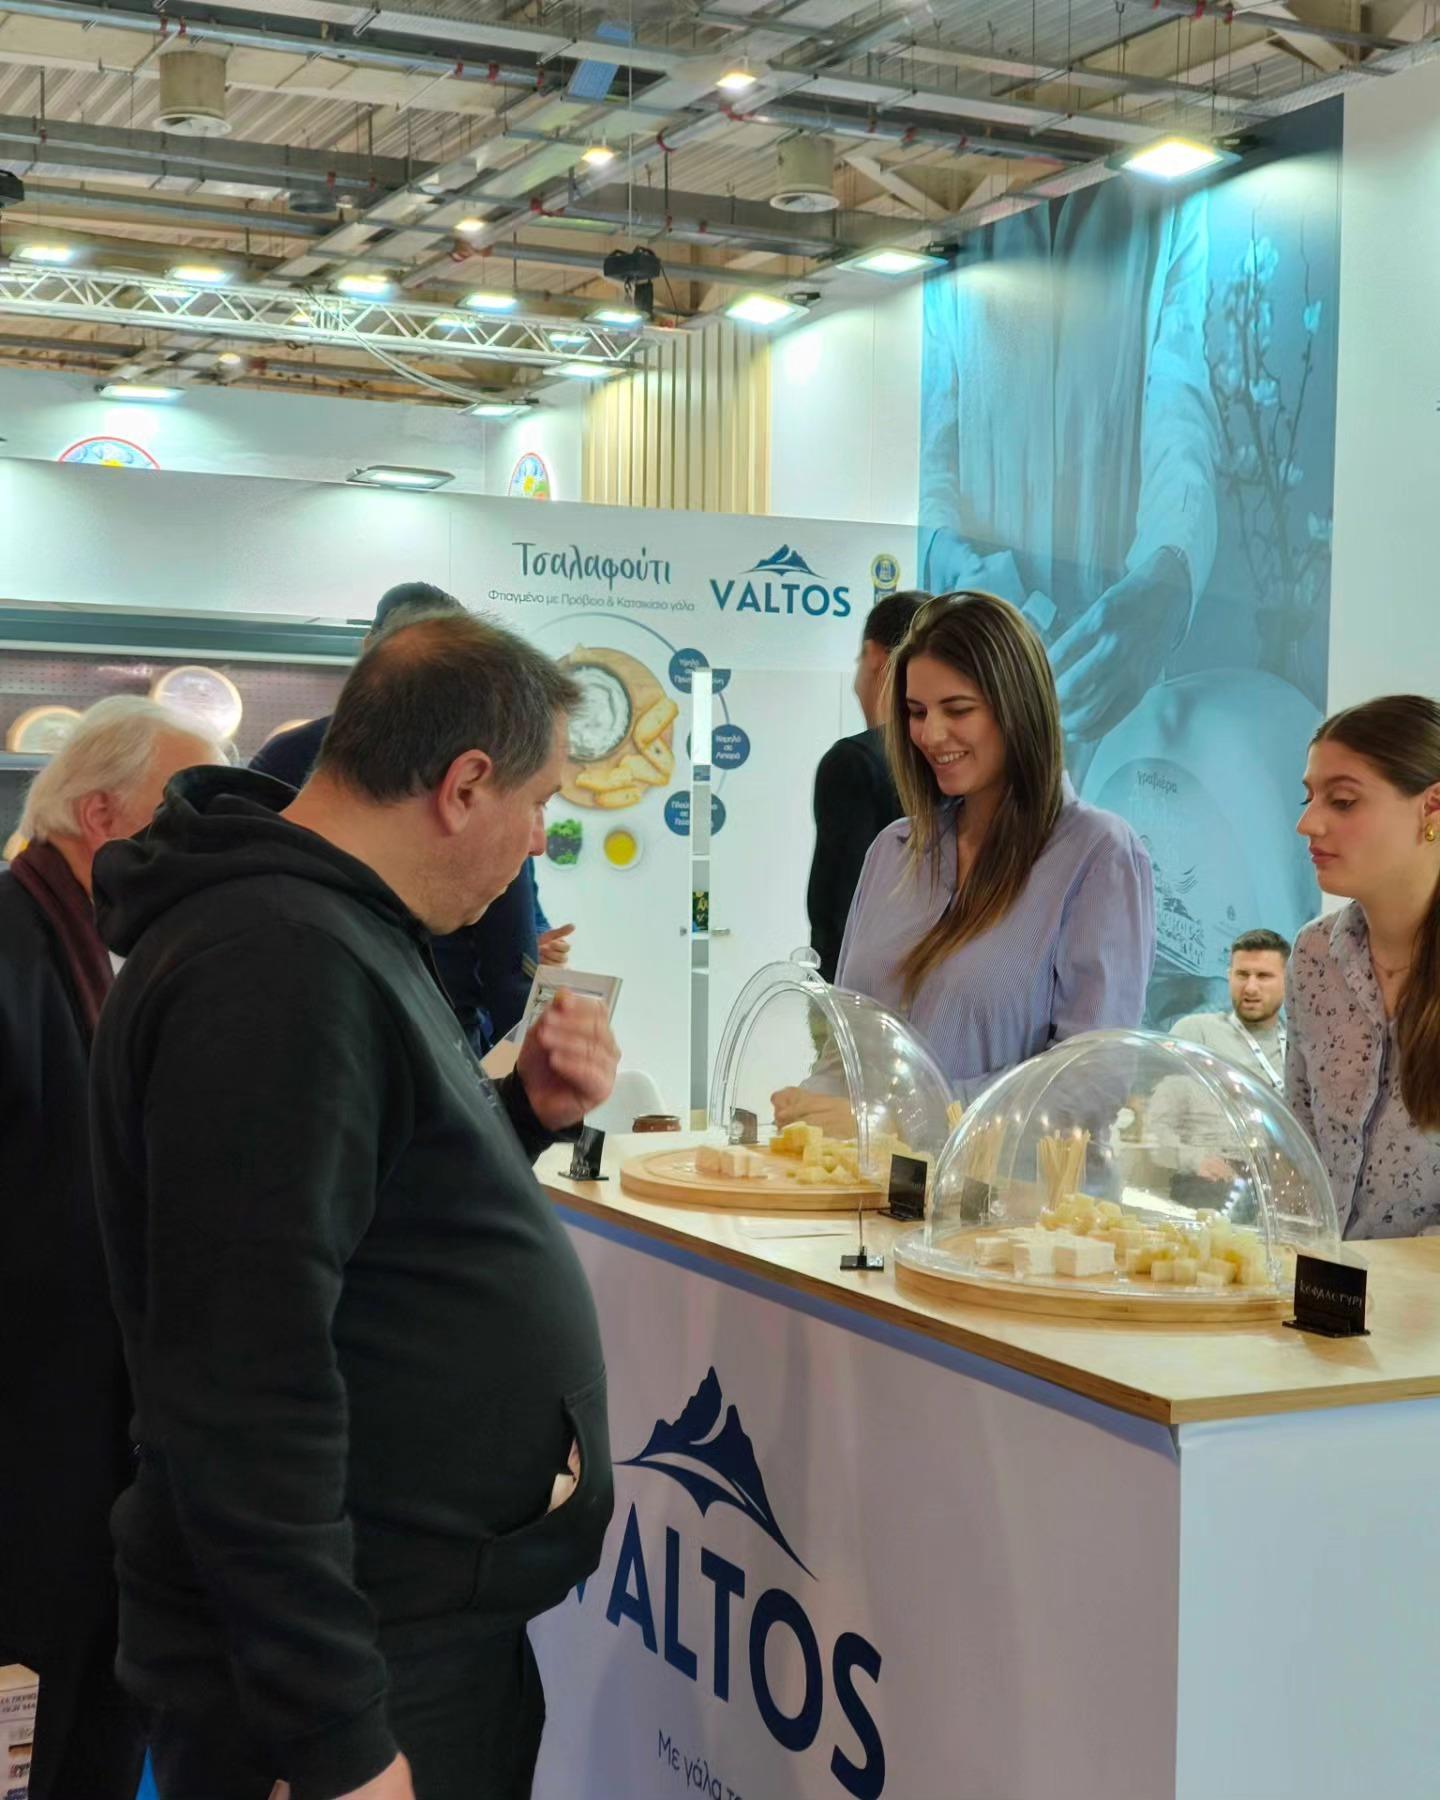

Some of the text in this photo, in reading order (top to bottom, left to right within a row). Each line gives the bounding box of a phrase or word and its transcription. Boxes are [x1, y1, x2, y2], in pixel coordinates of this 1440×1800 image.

[512, 542, 671, 591] Τσαλαφούτι
[709, 578, 852, 618] VALTOS
[575, 1502, 886, 1800] ALTOS
[658, 1728, 680, 1771] Με
[684, 1756, 722, 1800] γάλα
